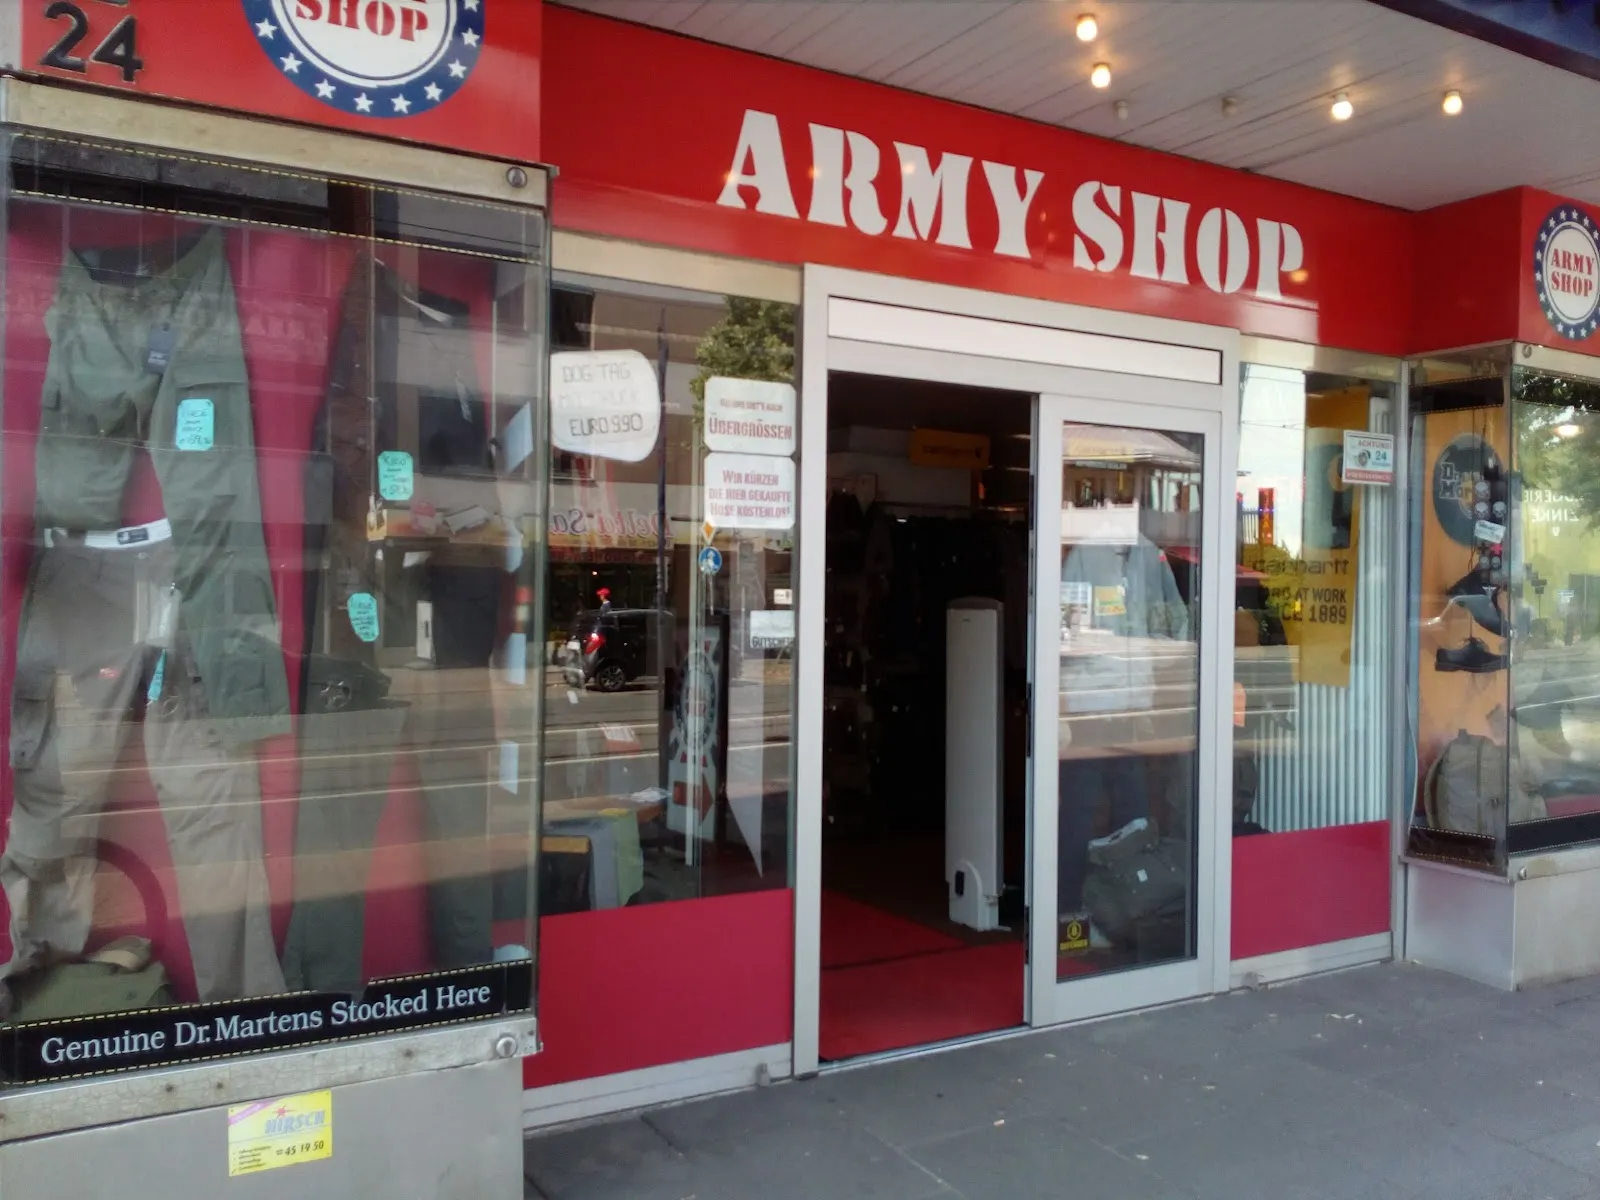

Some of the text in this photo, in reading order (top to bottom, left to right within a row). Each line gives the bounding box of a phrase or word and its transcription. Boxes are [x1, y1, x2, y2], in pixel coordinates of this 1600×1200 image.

[296, 0, 428, 42] SHOP
[38, 1, 144, 82] 24
[715, 108, 1304, 302] ARMY SHOP
[1550, 248, 1595, 276] ARMY
[1551, 270, 1593, 298] SHOP
[562, 362, 631, 383] DOG TAG
[569, 417, 609, 437] EURO
[708, 411, 793, 440] ÜBERGRÖSSEN
[1375, 450, 1387, 461] 24
[748, 489, 792, 503] GEKAUFTE
[1296, 587, 1310, 601] AT
[1312, 587, 1347, 603] WORK
[1309, 604, 1347, 625] 1889
[41, 1029, 166, 1064] Genuine
[331, 988, 428, 1026] Stocked
[435, 985, 491, 1011] Here
[264, 1109, 326, 1135] HIRSCH
[285, 1139, 325, 1156] 45 19 50
